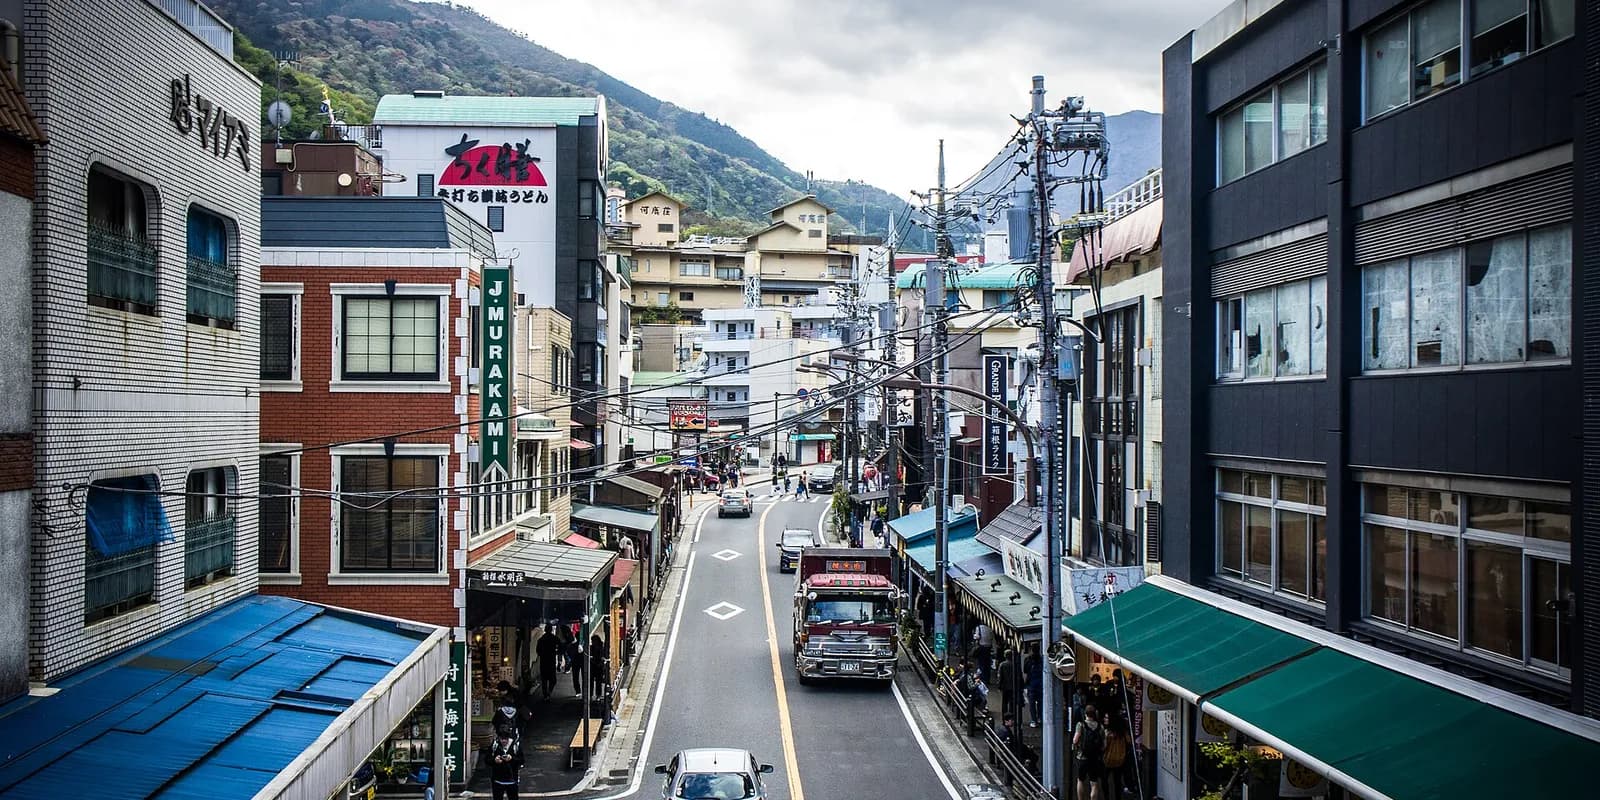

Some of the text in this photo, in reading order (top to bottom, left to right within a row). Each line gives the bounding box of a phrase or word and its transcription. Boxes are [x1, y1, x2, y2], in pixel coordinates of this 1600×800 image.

[991, 360, 1002, 393] GRANDE
[991, 425, 1002, 470] 箱根ラスク
